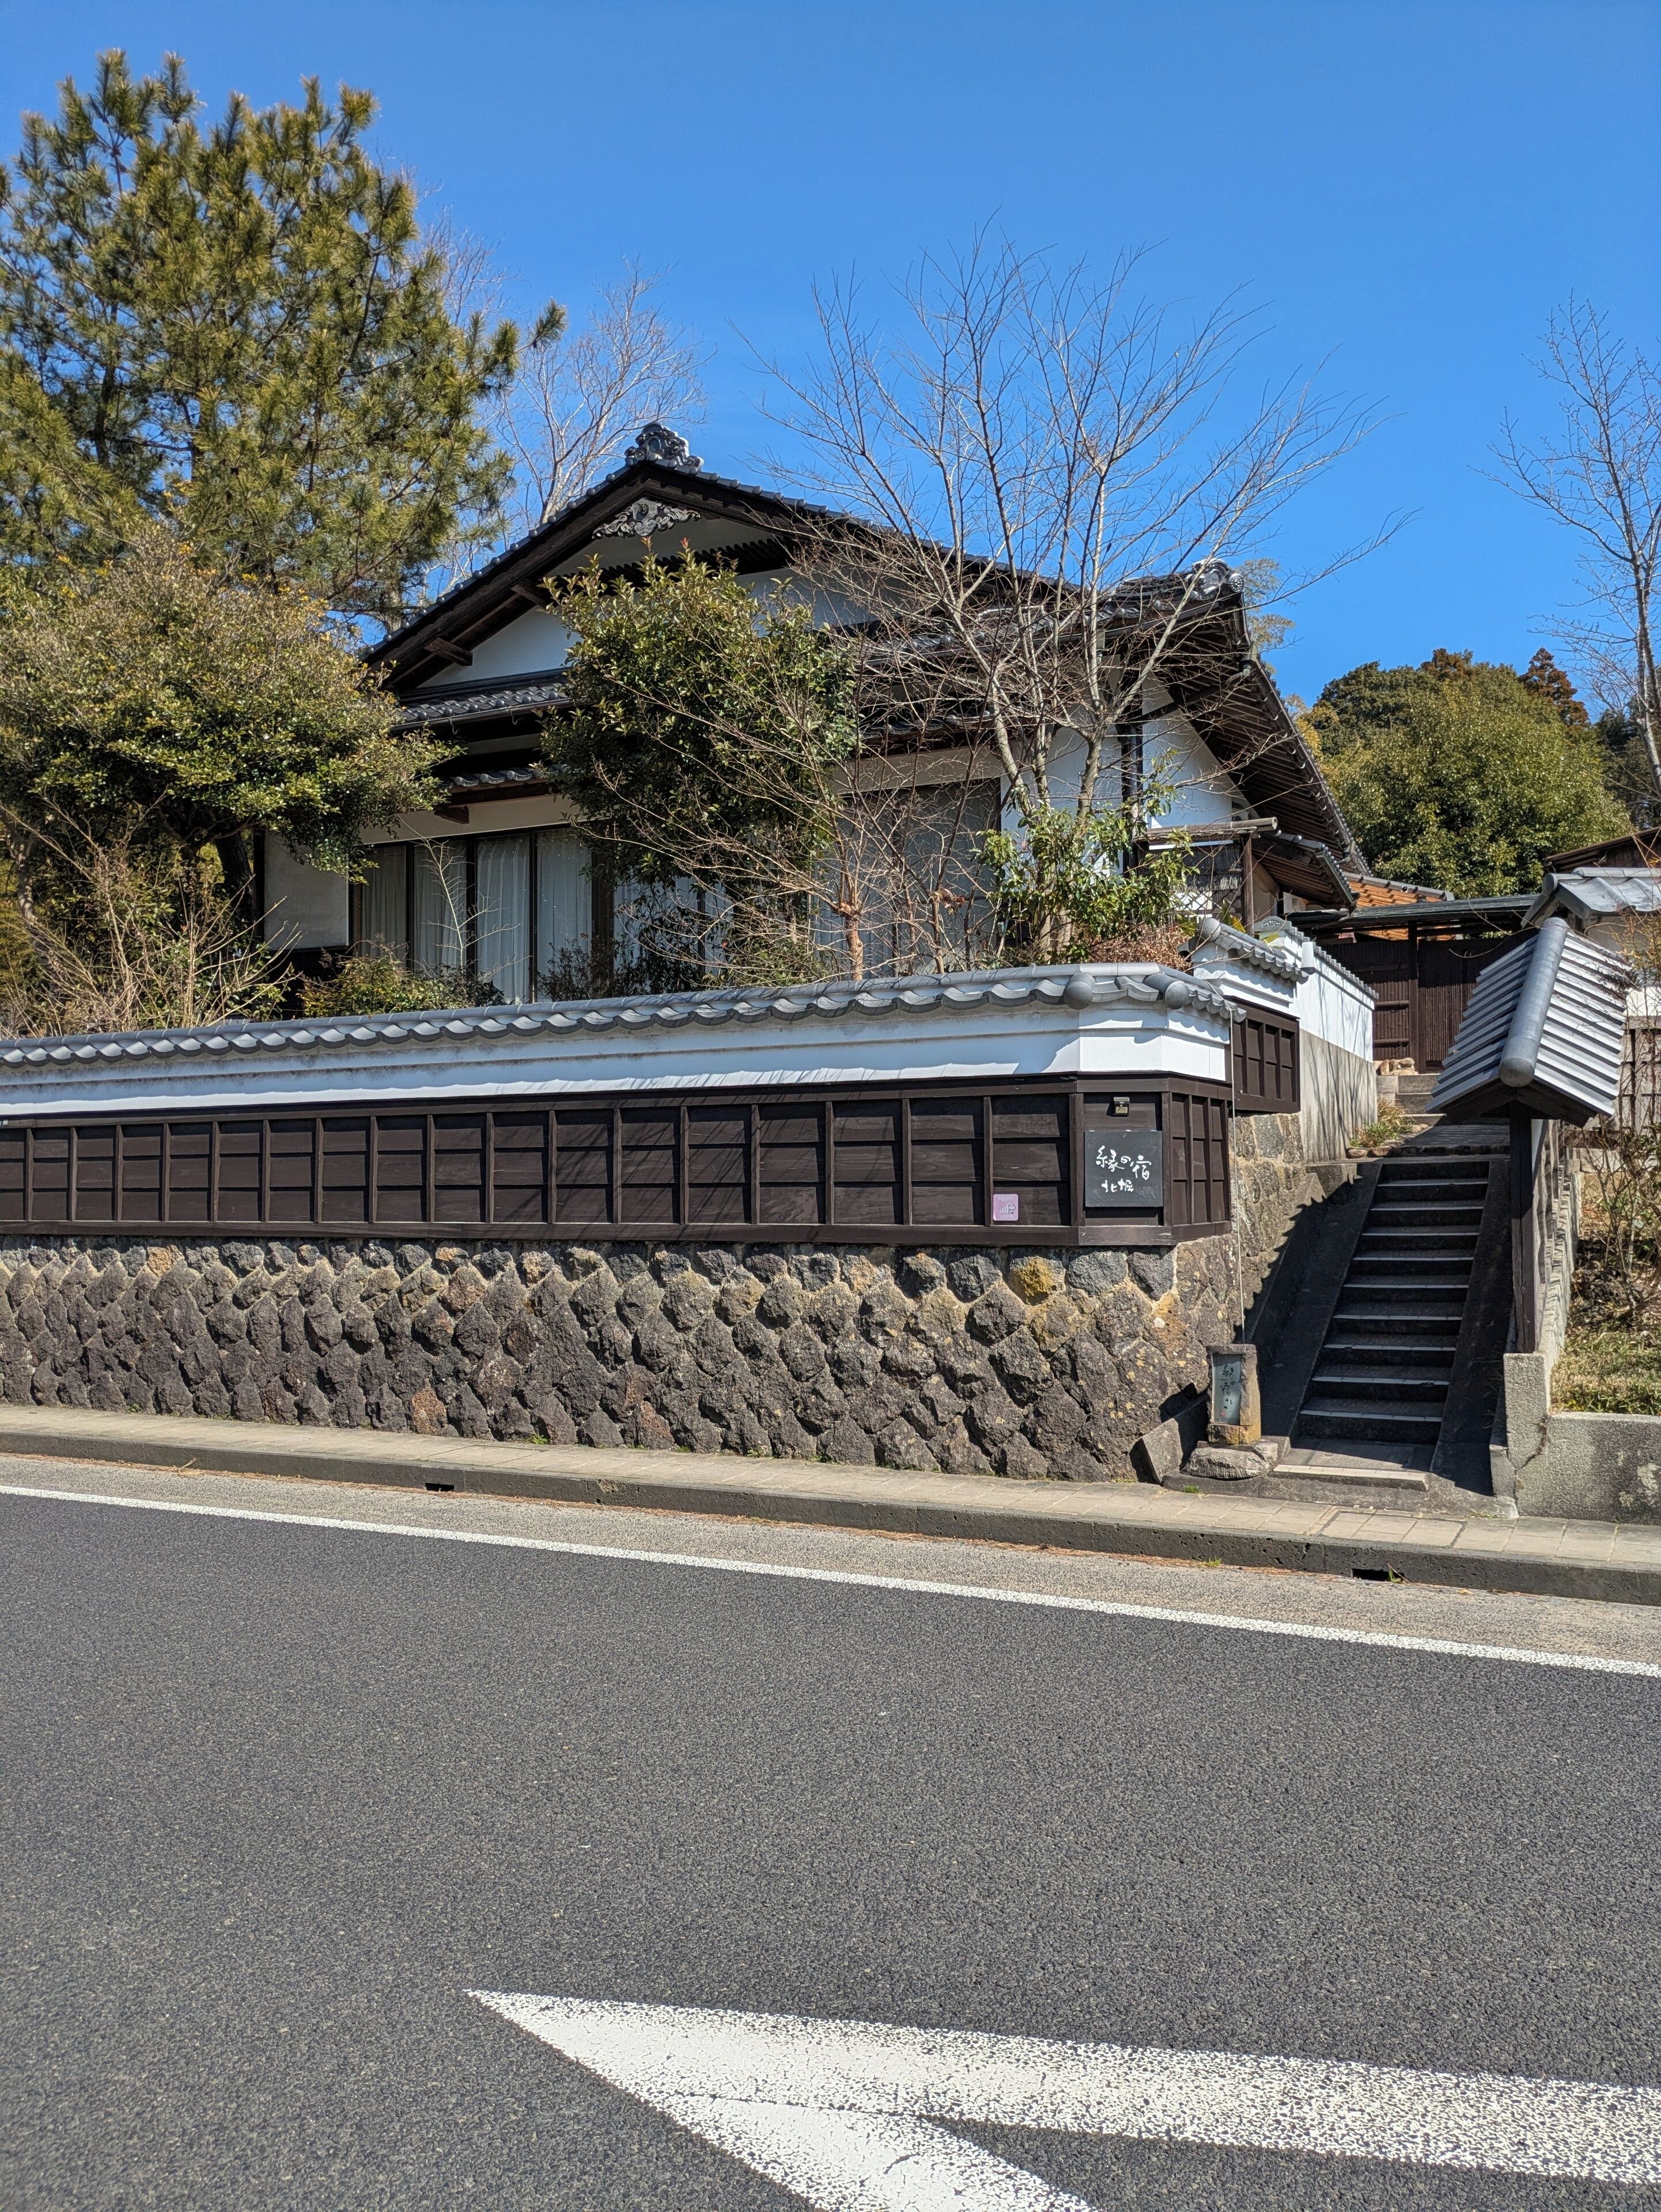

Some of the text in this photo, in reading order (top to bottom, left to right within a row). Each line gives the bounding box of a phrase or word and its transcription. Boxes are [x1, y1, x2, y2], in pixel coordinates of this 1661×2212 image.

[1096, 1145, 1152, 1180] 縁の宿
[1101, 1179, 1134, 1192] 北堀
